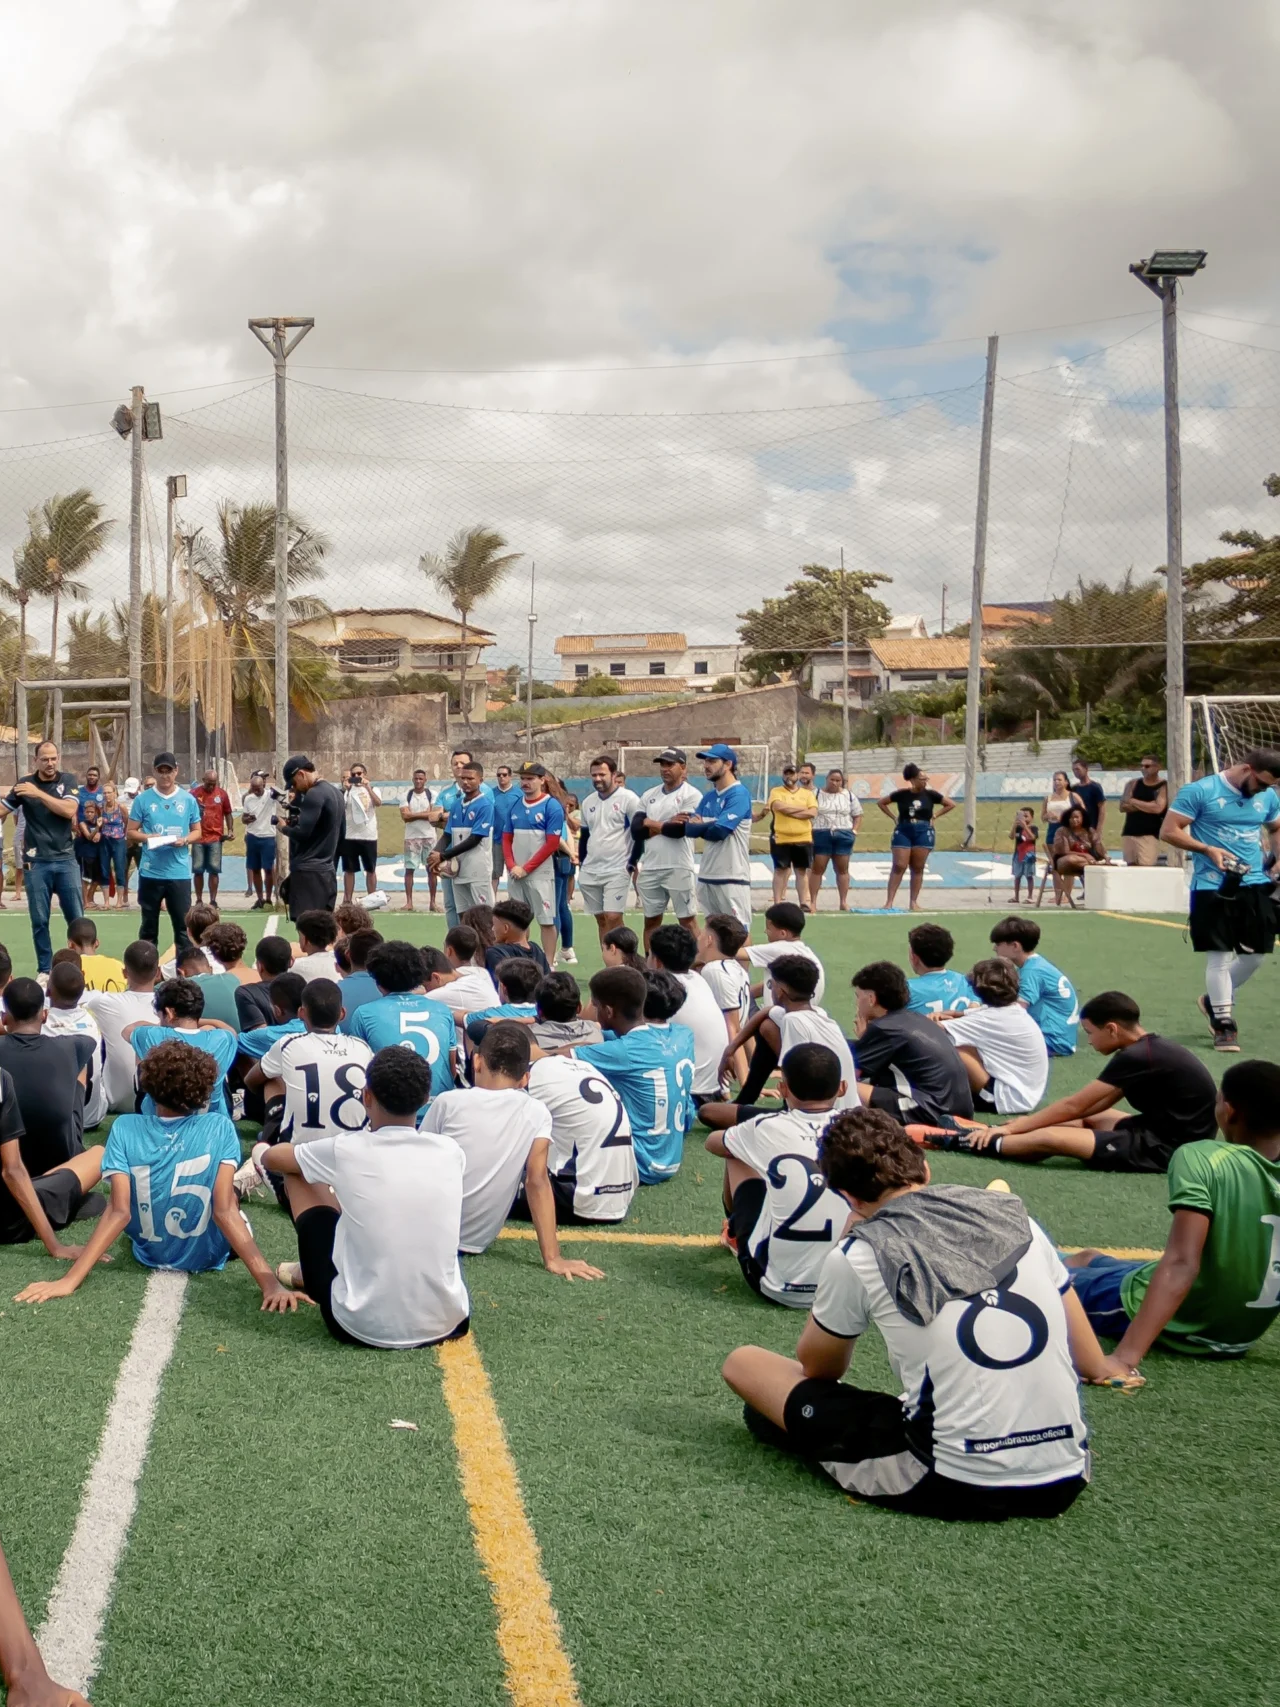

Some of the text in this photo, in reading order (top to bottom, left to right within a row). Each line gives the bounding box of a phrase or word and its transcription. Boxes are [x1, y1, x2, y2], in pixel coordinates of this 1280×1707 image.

[399, 1011, 440, 1065] 5
[295, 1062, 369, 1131] 18
[130, 1153, 212, 1243] 15
[767, 1153, 833, 1242] 2
